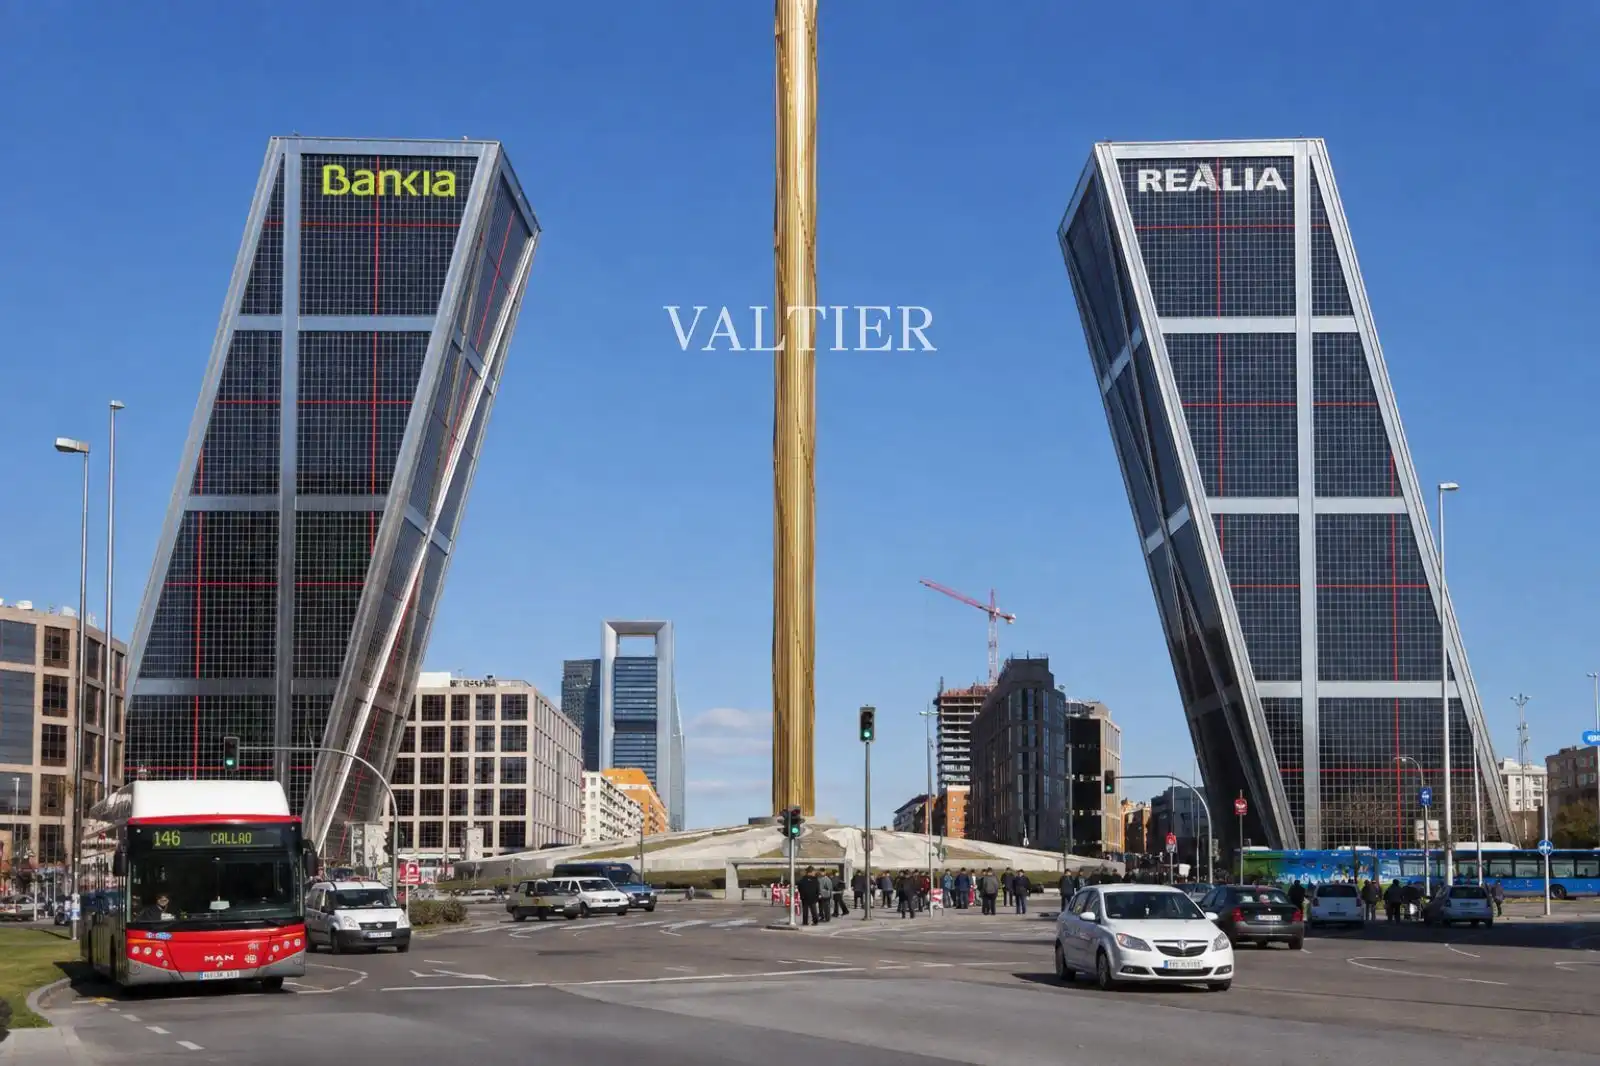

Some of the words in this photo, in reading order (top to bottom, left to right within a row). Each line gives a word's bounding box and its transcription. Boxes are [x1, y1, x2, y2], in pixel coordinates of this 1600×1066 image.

[322, 164, 456, 197] Bankia
[1138, 163, 1287, 192] REALIA
[154, 831, 181, 847] 146
[211, 832, 252, 845] CALLAO
[204, 954, 234, 962] MAN
